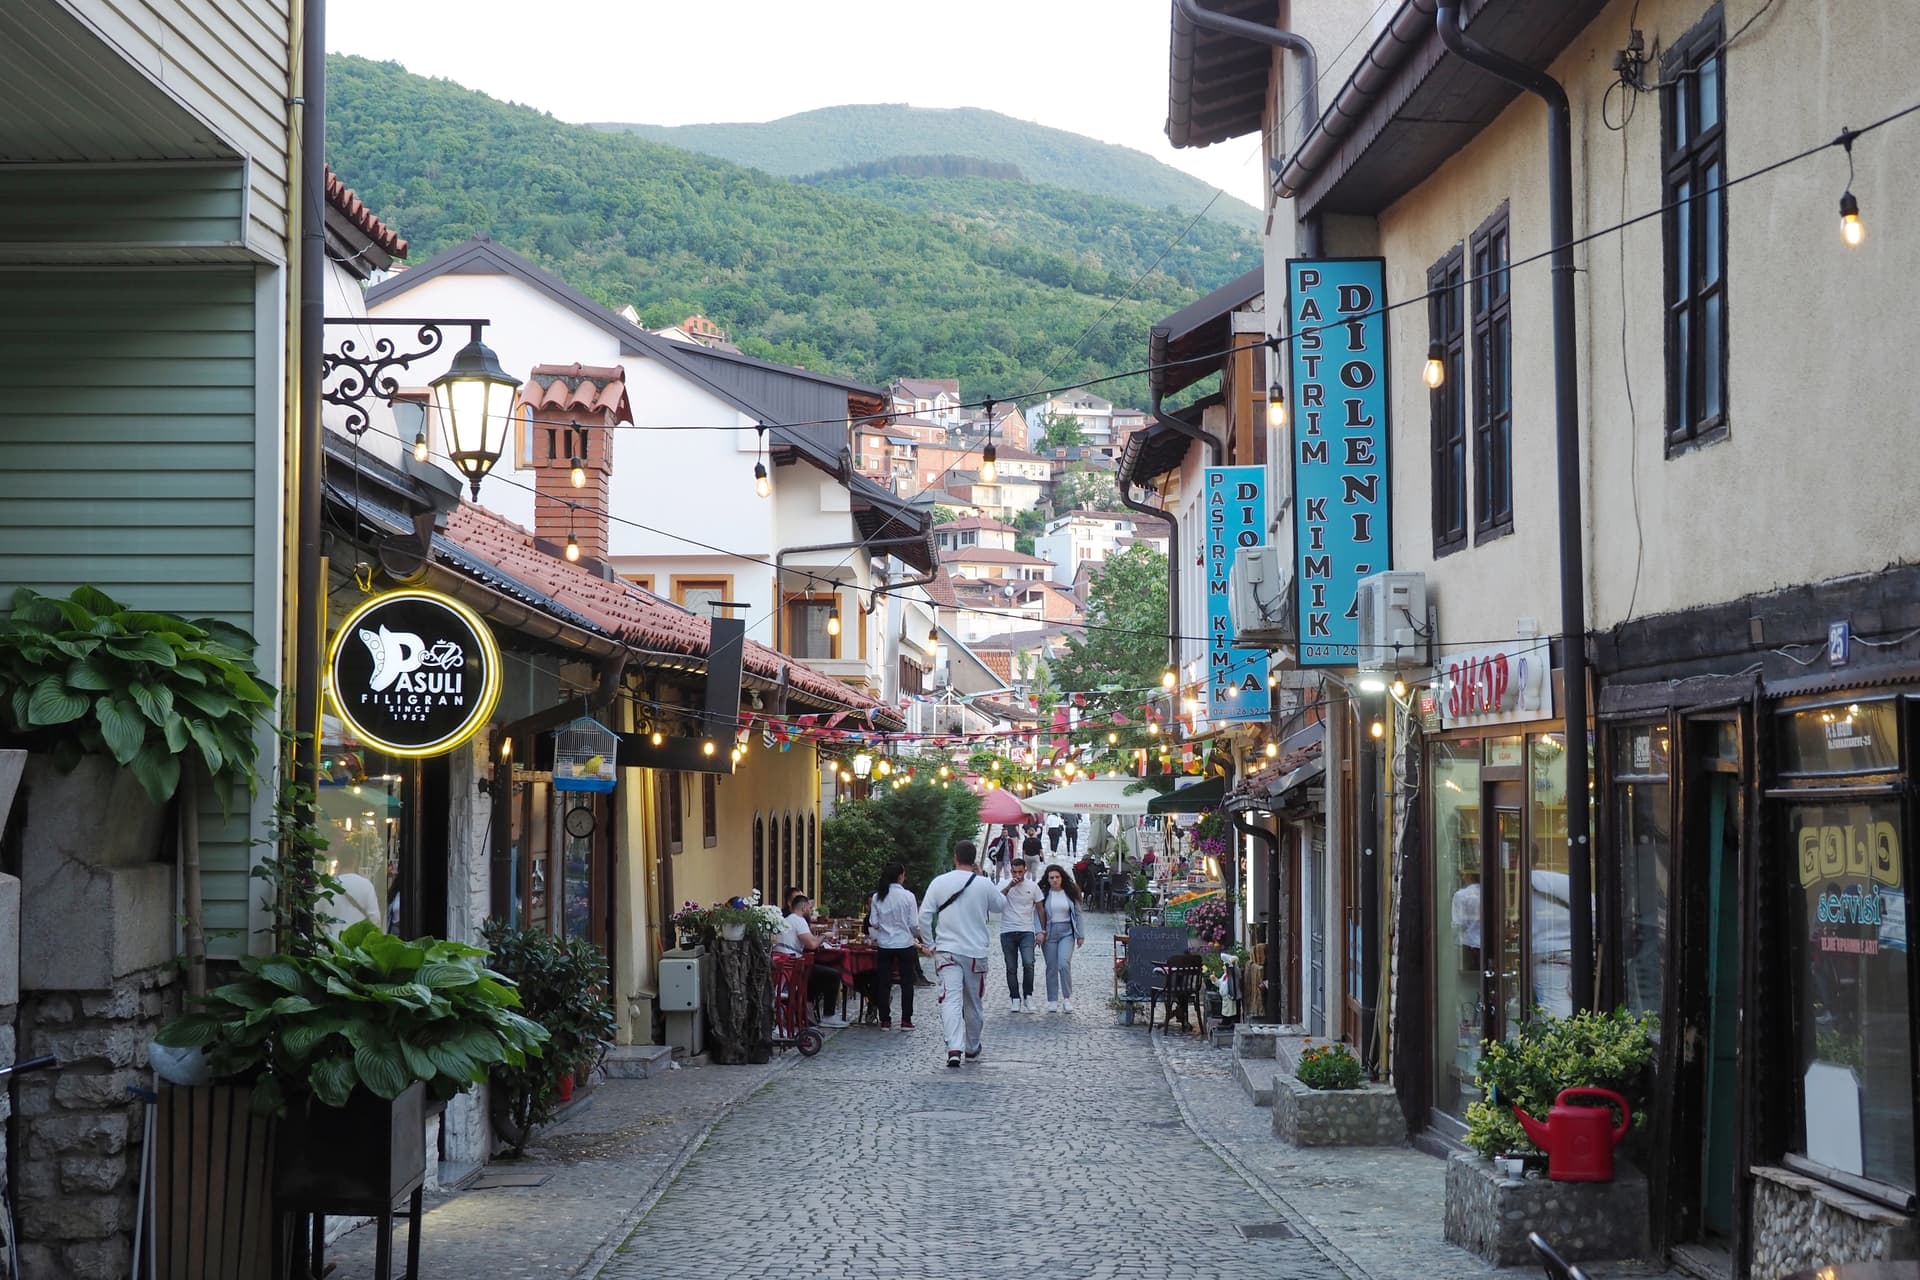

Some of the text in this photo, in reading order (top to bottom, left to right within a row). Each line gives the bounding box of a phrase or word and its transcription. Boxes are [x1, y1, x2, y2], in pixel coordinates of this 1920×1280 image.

[1298, 269, 1332, 637] PASTRIM KIMIK
[1210, 473, 1229, 703] PASTRIM KIMIK
[1306, 645, 1330, 658] 044
[361, 693, 463, 706] FILIGRAN
[1448, 652, 1509, 718] SHOP
[389, 705, 431, 713] SINCE
[394, 714, 426, 722] 1952
[1799, 822, 1900, 889] GOLD
[1817, 884, 1882, 926] servisi
